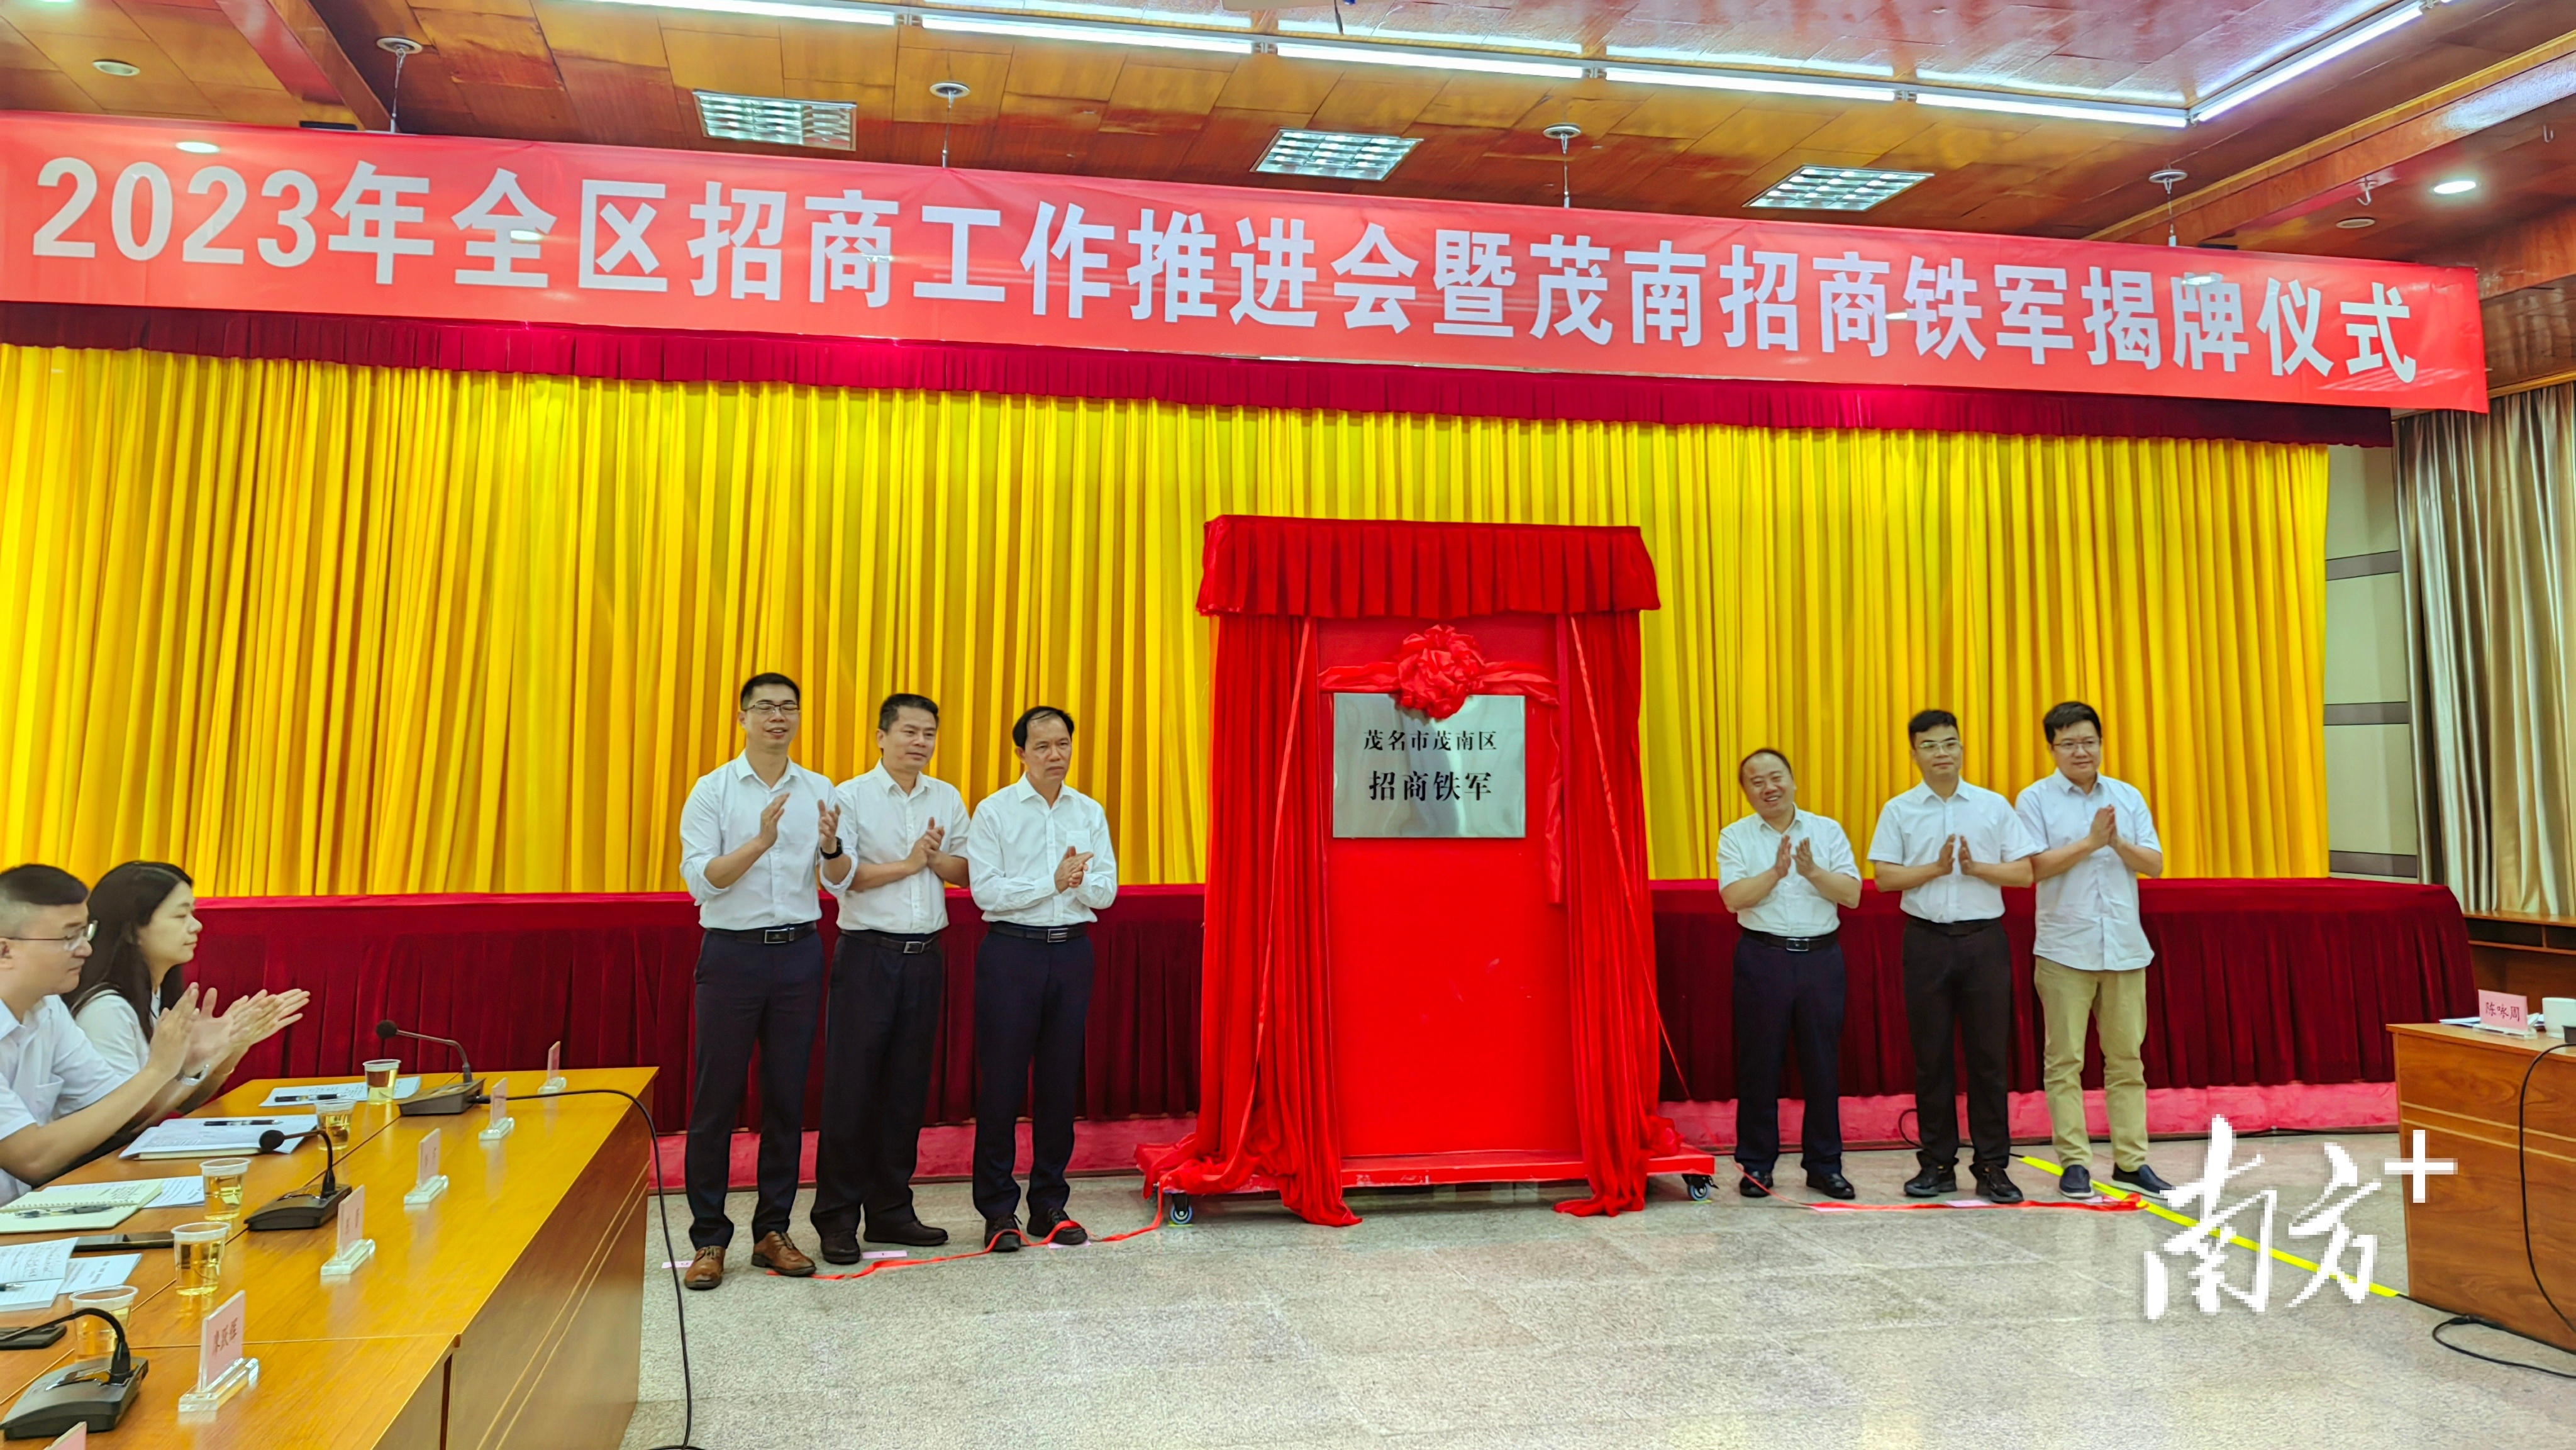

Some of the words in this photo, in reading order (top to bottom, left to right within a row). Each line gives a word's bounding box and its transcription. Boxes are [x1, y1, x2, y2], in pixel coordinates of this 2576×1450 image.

[33, 157, 2416, 383] 2023年全区招商工作推进会暨茂南招商铁军揭牌仪式
[1363, 729, 1497, 752] 茂名市茂南区
[1368, 770, 1492, 802] 招商铁军
